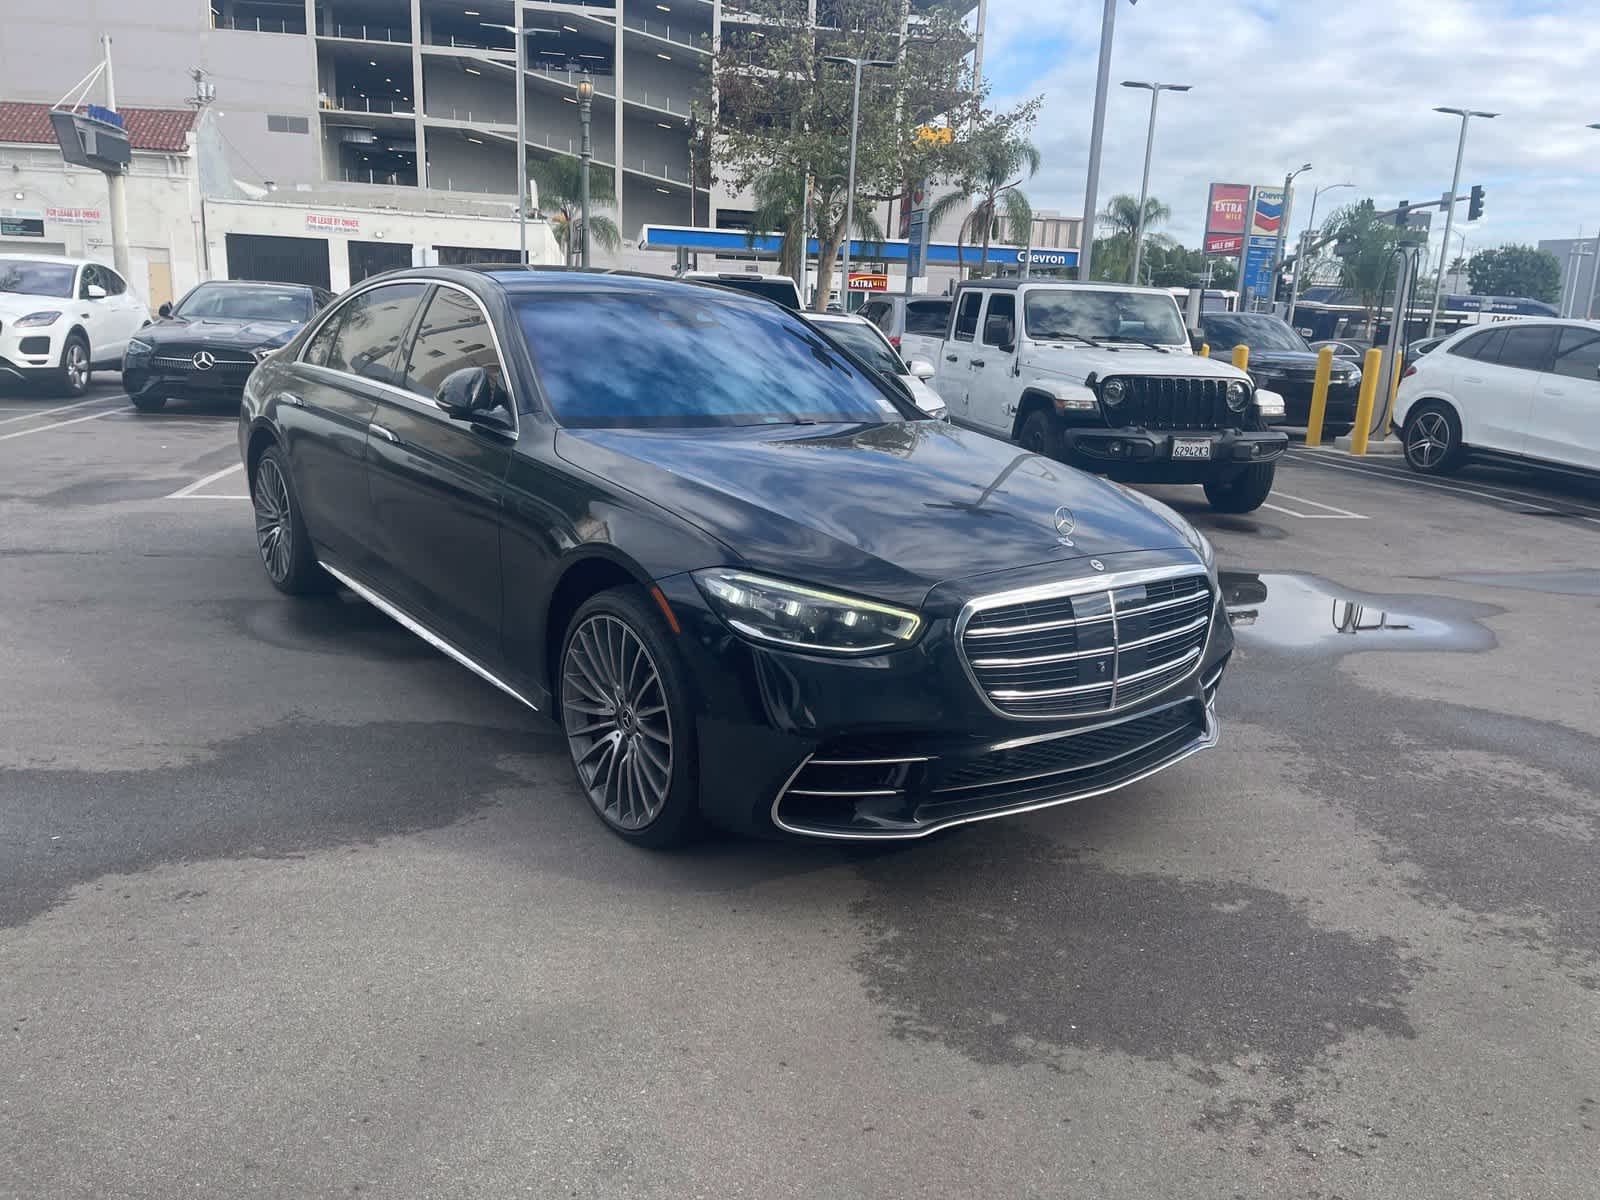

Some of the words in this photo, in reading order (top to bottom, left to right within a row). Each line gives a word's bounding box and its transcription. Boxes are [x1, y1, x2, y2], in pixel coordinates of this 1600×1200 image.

[1215, 202, 1242, 213] EXTRA
[46, 208, 56, 216] FOR
[57, 208, 74, 217] LEASE
[82, 209, 100, 218] OWNER
[306, 215, 317, 223] FOR
[318, 216, 333, 225] LEASE
[341, 218, 359, 227] OWNER
[851, 280, 872, 288] EXTRA
